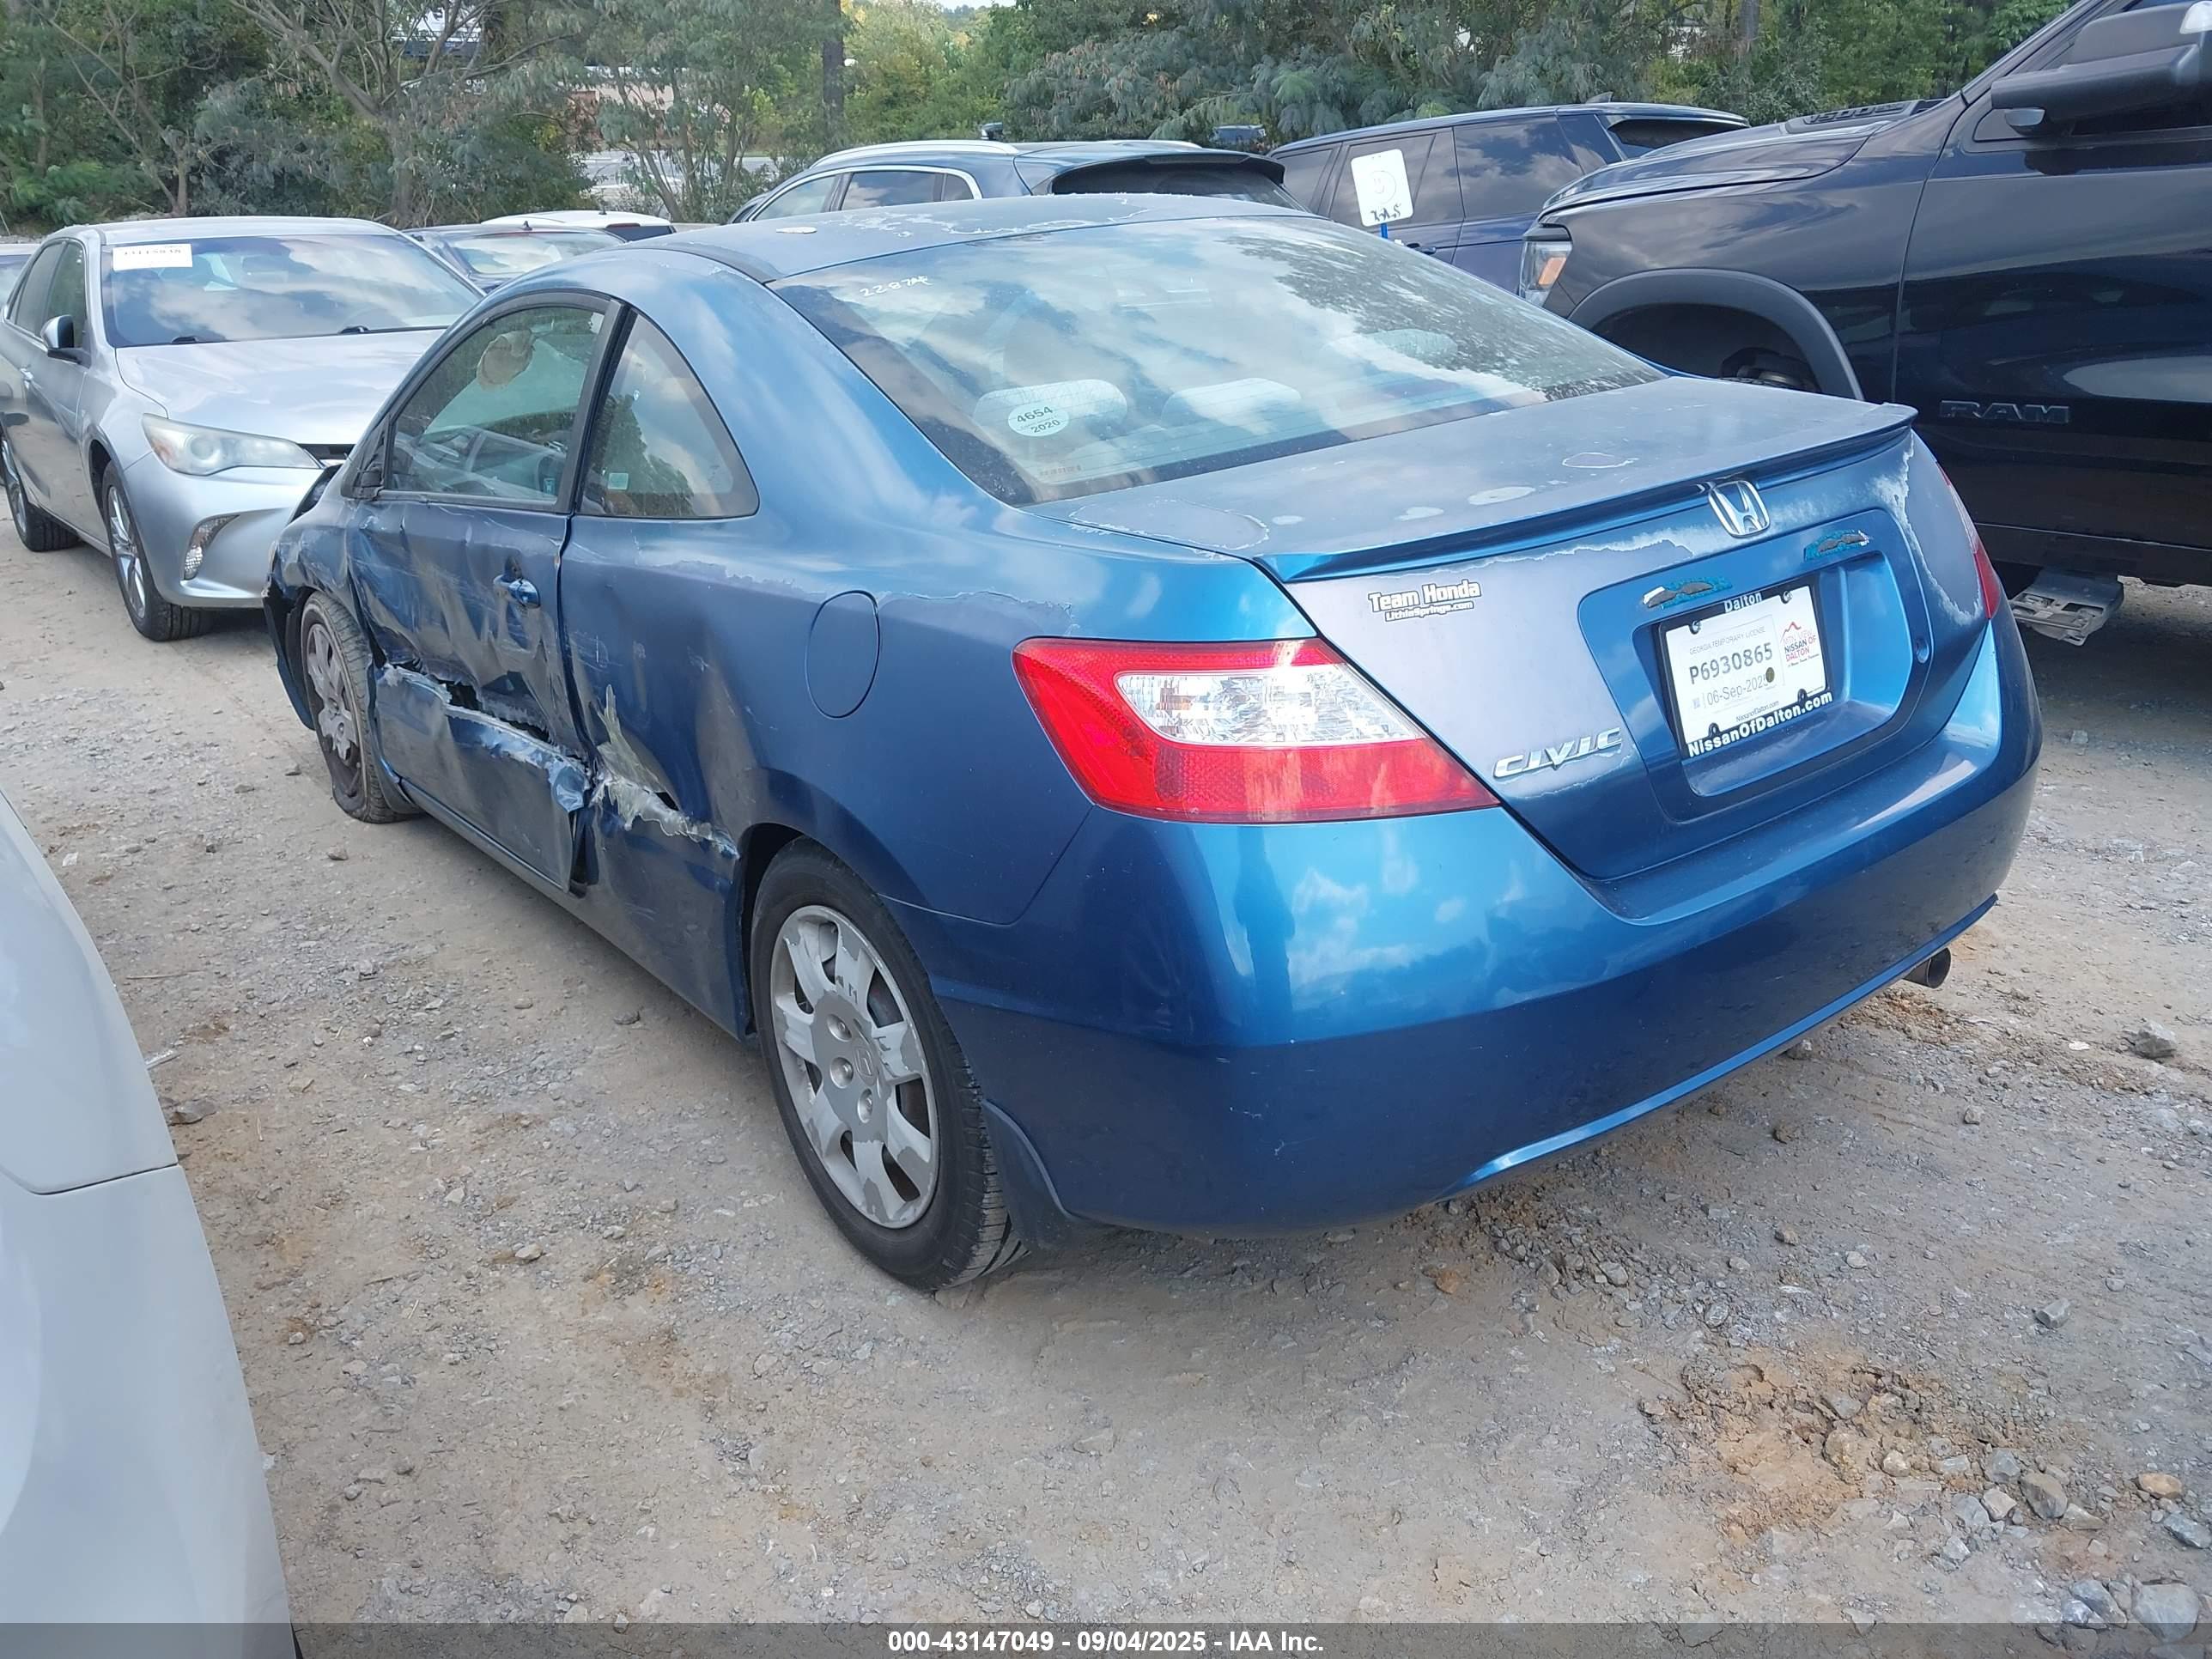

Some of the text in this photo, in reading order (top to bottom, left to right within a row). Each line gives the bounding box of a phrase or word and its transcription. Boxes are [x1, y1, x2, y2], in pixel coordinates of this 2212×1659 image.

[1017, 406, 1053, 422] 4654
[1939, 399, 2070, 424] RAM
[1030, 419, 1060, 433] 2020
[1368, 579, 1481, 612] Team Honda
[1723, 592, 1762, 613] Dalton
[1689, 626, 1766, 655] GEORGIA TEMPORARY LICENSE
[1784, 635, 1817, 653] NISSAN OF
[1689, 642, 1773, 685] P6930865
[1785, 646, 1810, 662] DALTON
[1688, 691, 1833, 757] NissanOfDalton.com
[1493, 727, 1623, 779] CIVIC
